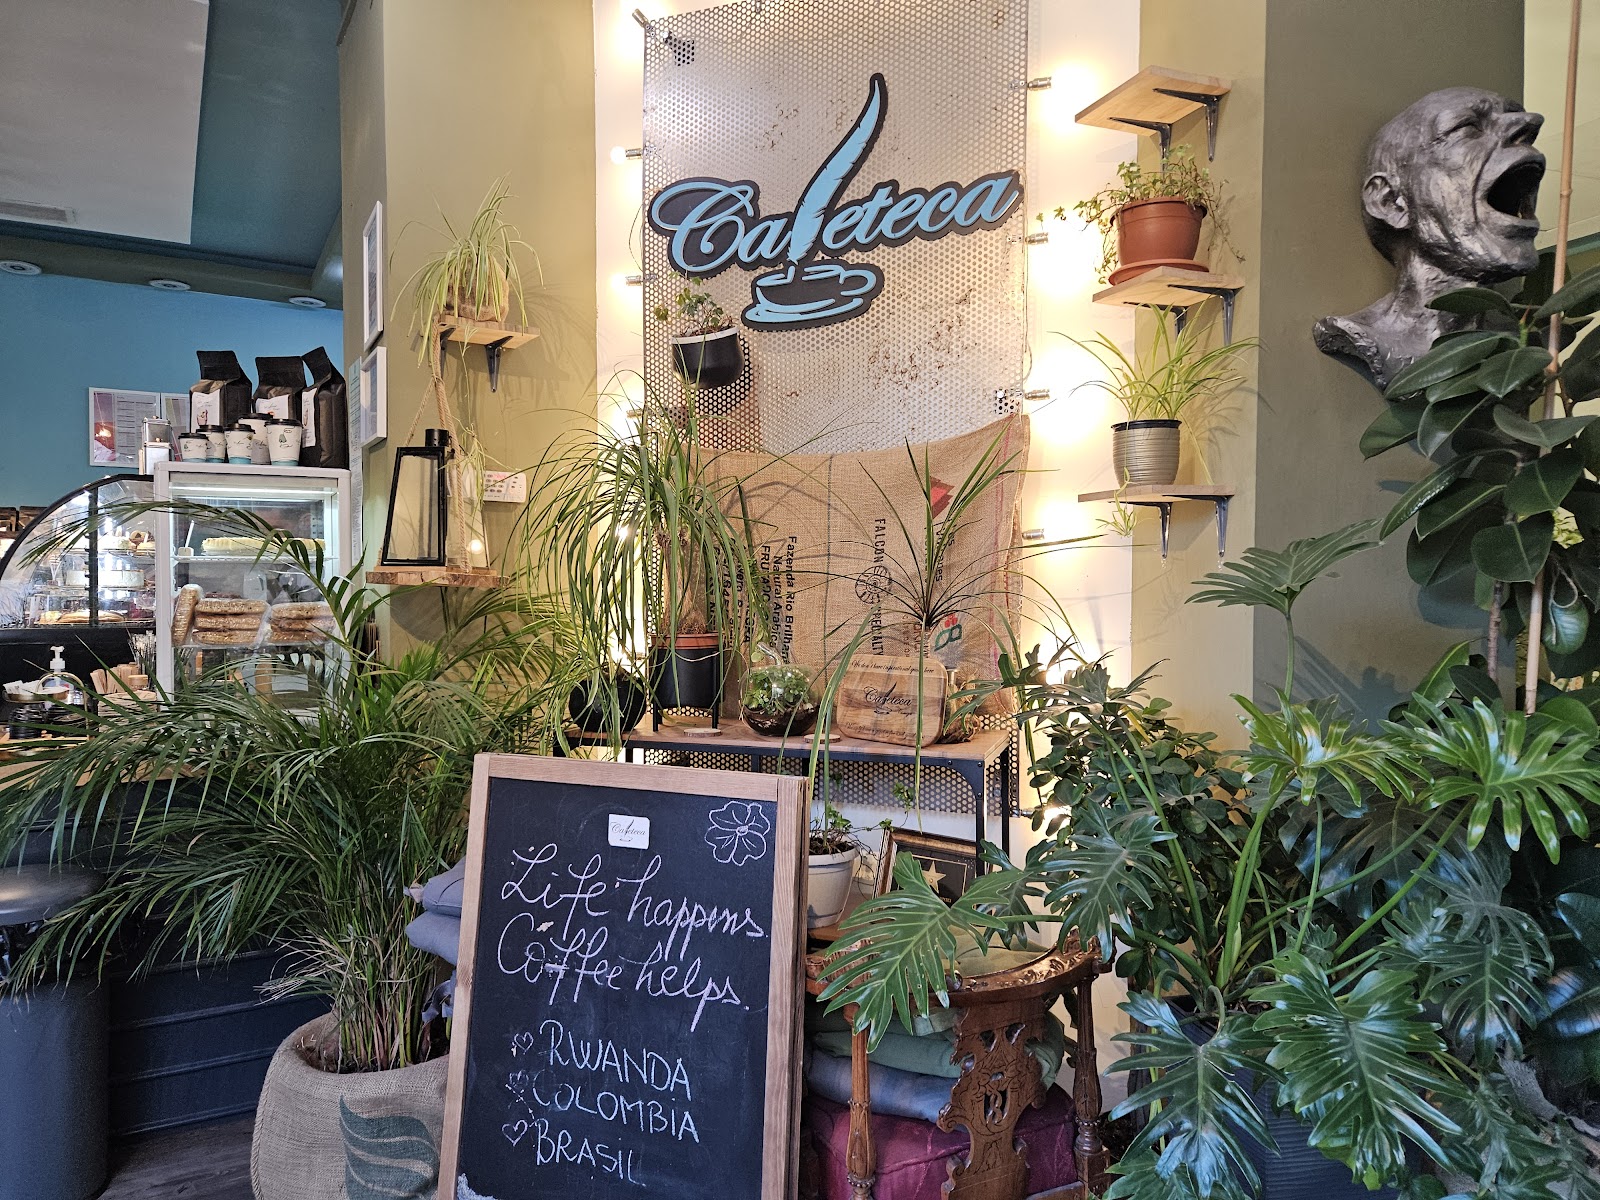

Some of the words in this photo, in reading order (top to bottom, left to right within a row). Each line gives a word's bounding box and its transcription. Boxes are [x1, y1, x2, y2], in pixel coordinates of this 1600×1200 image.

[649, 76, 1021, 274] Cafeteca
[786, 536, 797, 587] Fazenda
[873, 518, 886, 563] FALCON
[501, 843, 609, 941] Life
[497, 912, 622, 1006] Coffee
[539, 1019, 692, 1102] RWANDA
